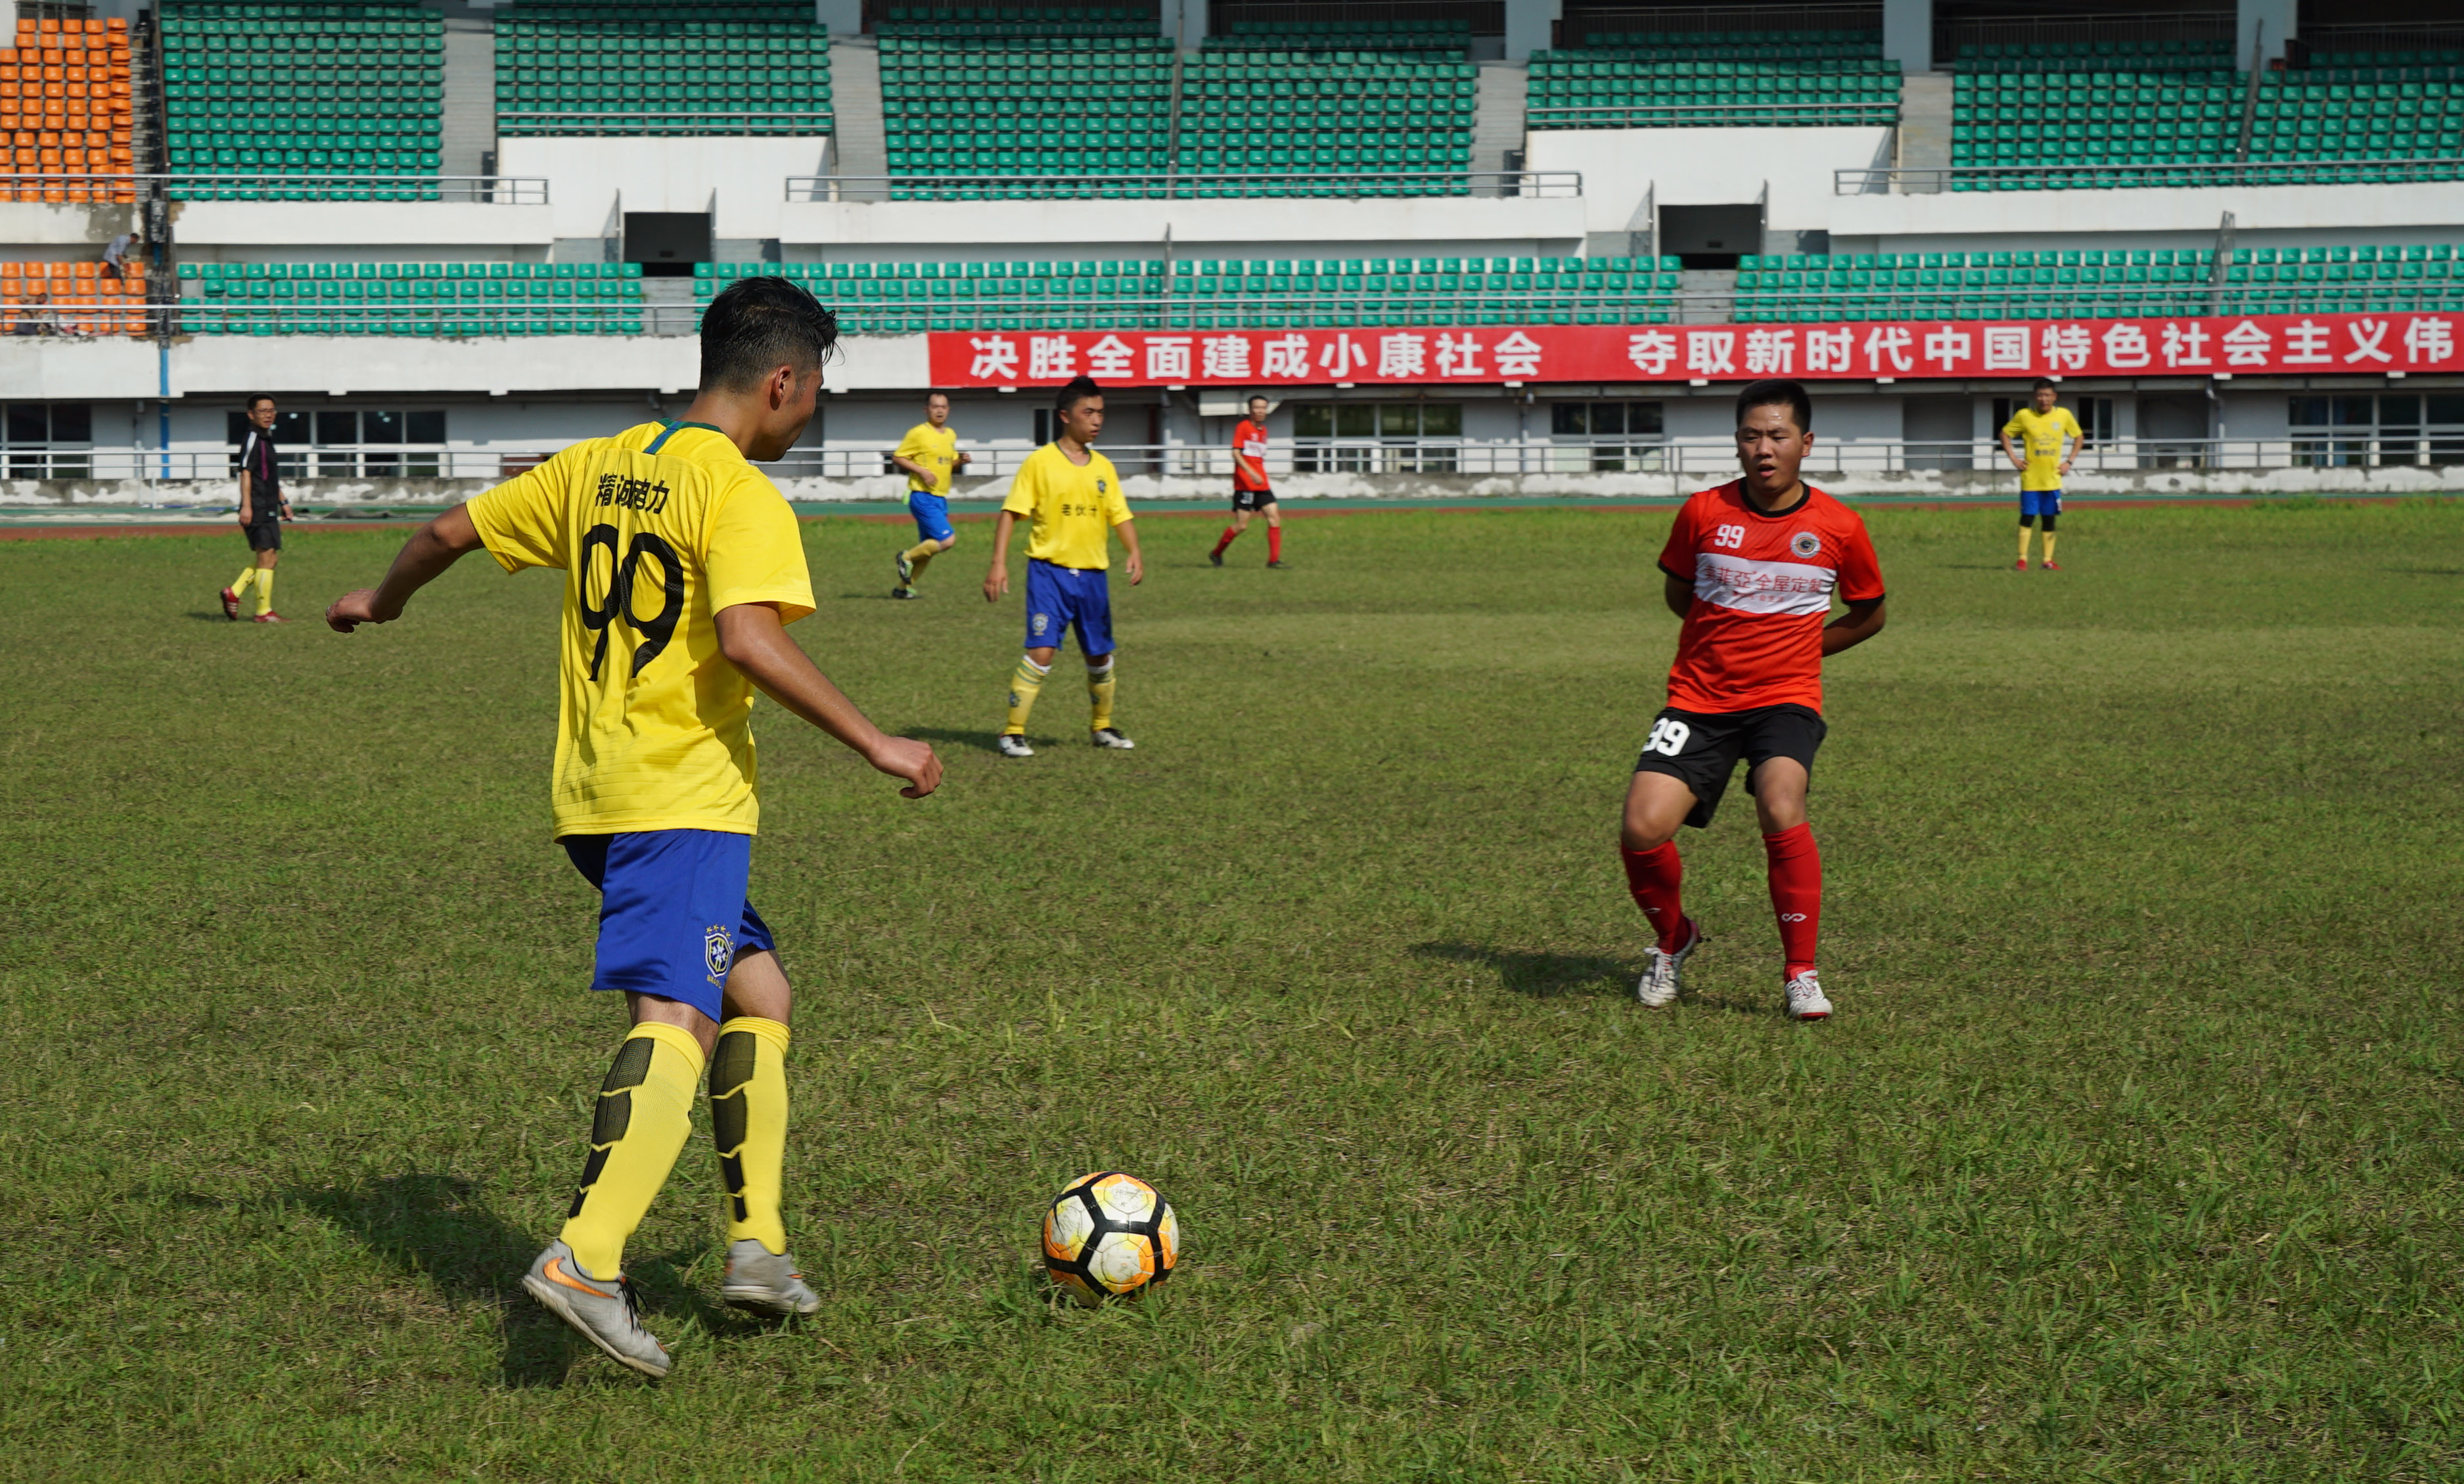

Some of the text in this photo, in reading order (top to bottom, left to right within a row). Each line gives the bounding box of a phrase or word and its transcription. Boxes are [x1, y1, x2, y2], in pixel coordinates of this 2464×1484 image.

[970, 317, 2453, 379] 决胜全面建成小康社会 夺取新时代中国特色社会主义伟
[595, 473, 670, 514] 精诚电力
[1714, 524, 1745, 549] 99
[581, 524, 684, 681] 99
